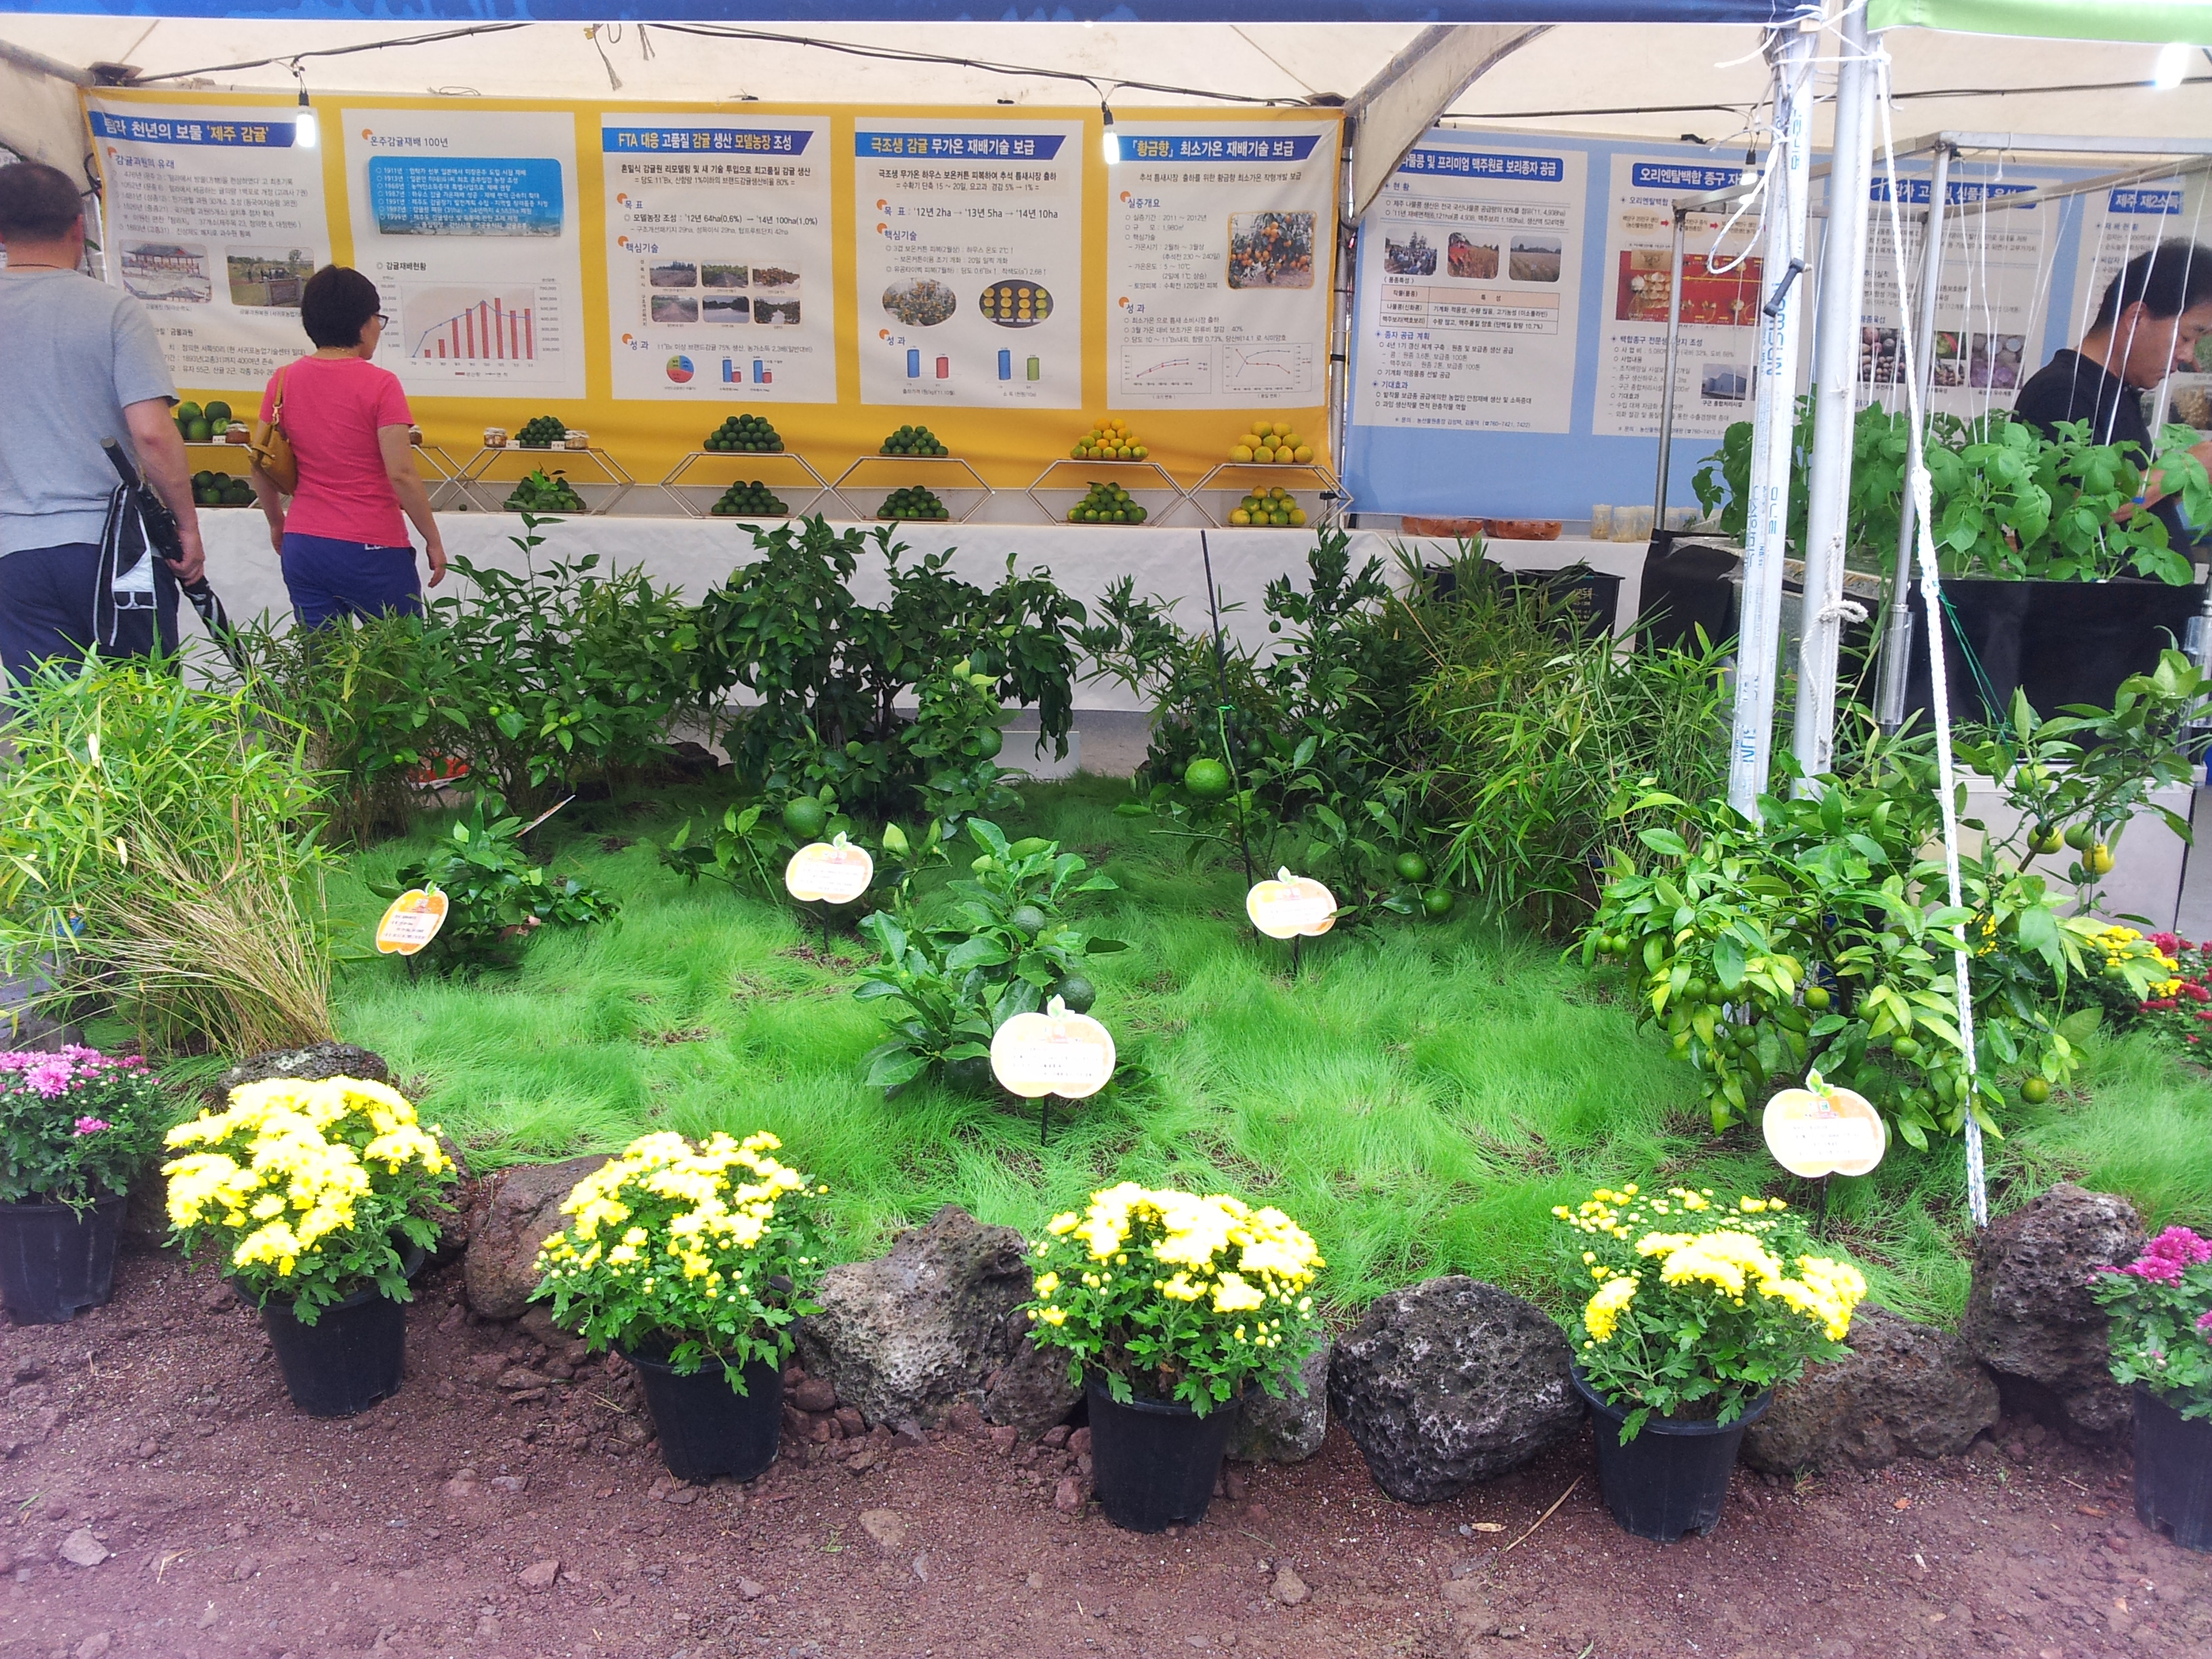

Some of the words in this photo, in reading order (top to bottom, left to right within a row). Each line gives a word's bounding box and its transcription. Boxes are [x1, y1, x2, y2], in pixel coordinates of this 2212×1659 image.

[131, 121, 171, 139] 천년의
[176, 123, 202, 140] 보물
[370, 136, 421, 147] 온주감귤재배
[424, 138, 448, 148] 100년
[617, 133, 638, 146] FTA
[640, 131, 659, 148] 대응
[661, 132, 689, 148] 고품질
[692, 132, 711, 148] 감귤
[713, 133, 733, 148] 생산
[734, 134, 771, 150] 모델농장
[773, 134, 792, 150] 조성
[870, 137, 903, 153] 극조생
[907, 138, 928, 154] 감귤
[931, 138, 964, 154] 무가온
[966, 138, 1010, 155] 재배기술
[1012, 140, 1035, 155] 보급
[1179, 140, 1223, 157] 최소가온
[1225, 140, 1269, 157] 재배기술
[1271, 140, 1294, 156] 보급
[665, 164, 691, 173] 리모델링
[693, 165, 699, 174] 및
[701, 165, 708, 174] 새
[710, 165, 724, 174] 기술
[726, 165, 752, 175] 투입으로
[797, 167, 811, 176] 생산
[1427, 155, 1435, 169] 및
[1437, 155, 1469, 171] 프리미엄
[1471, 157, 1504, 173] 맥주원료
[1505, 159, 1538, 176] 보리종자
[1539, 161, 1556, 176] 공급
[900, 169, 920, 179] 무가온
[922, 170, 941, 179] 하우스
[1000, 171, 1013, 180] 추석
[1639, 167, 1702, 184] 오리엔탈백합
[1704, 171, 1725, 186] 종구
[775, 178, 789, 186] 80%
[633, 213, 661, 222] 모델농장
[662, 213, 676, 222] 조성
[935, 207, 951, 217] 2ha
[987, 208, 1002, 218] 5ha
[1038, 209, 1058, 218] 10ha
[884, 230, 917, 241] 핵심기술
[626, 243, 659, 253] 핵심기술
